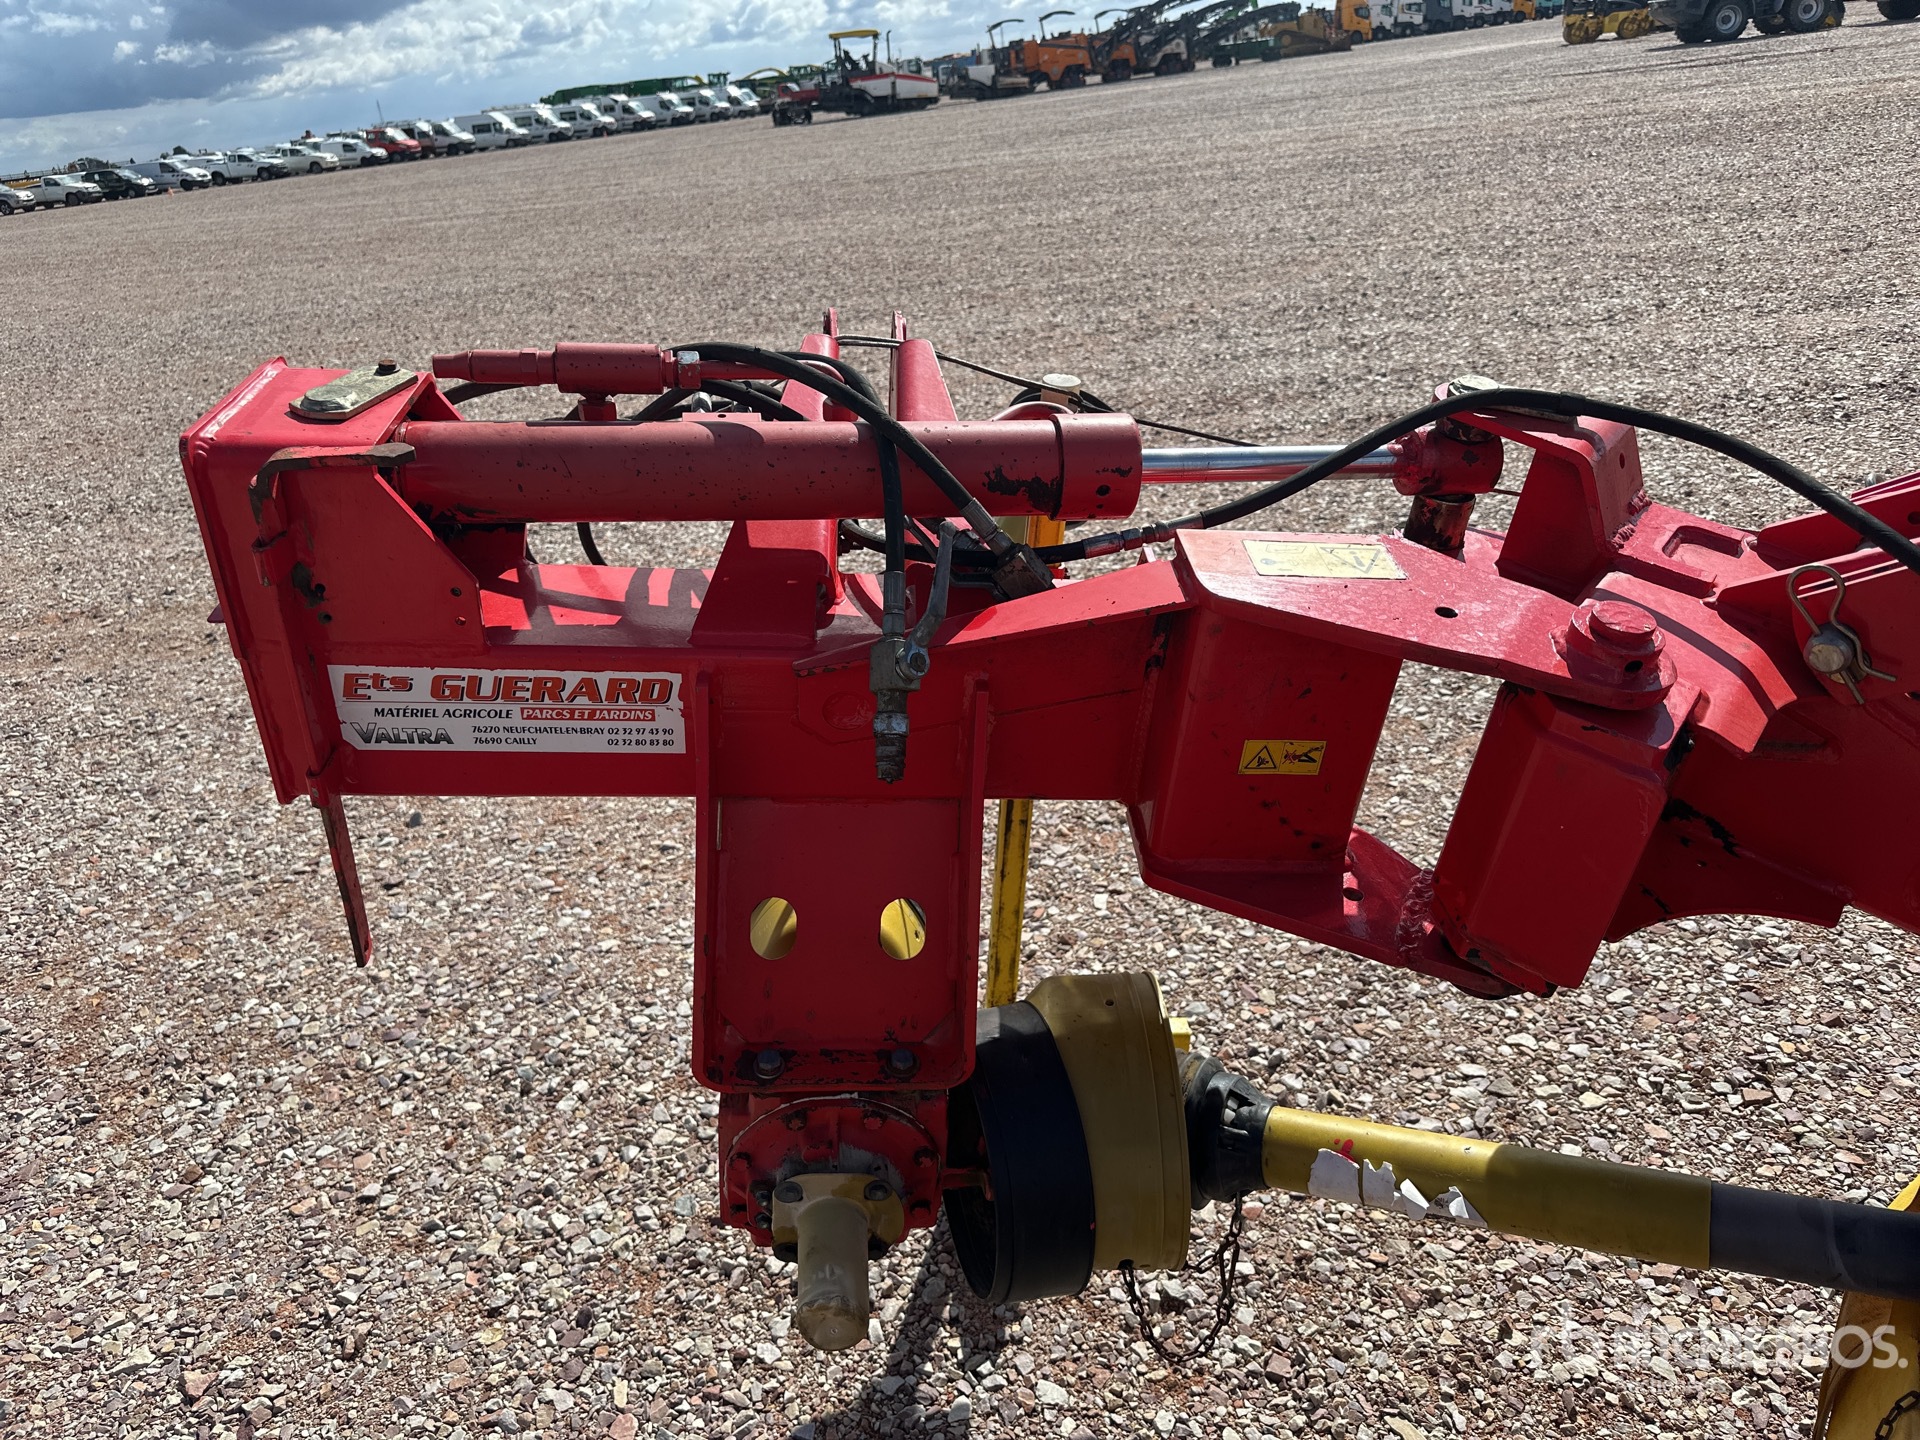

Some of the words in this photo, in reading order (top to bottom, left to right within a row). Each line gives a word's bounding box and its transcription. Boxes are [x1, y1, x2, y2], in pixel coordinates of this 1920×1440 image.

[342, 672, 414, 700] Ets
[430, 674, 674, 705] GUERARD
[373, 705, 440, 719] MATÉRIEL
[442, 708, 514, 720] AGRICOLE
[522, 709, 571, 719] PARCS
[573, 710, 593, 720] ET
[593, 710, 653, 721] JARDINS
[350, 722, 455, 745] VALTRA
[471, 725, 501, 734] 76270
[607, 727, 619, 736] 02
[622, 727, 633, 736] 32
[635, 728, 647, 736] 97
[648, 728, 660, 736] 43
[662, 728, 674, 736] 90
[473, 737, 502, 745] 76690
[504, 737, 538, 745] CAILLY
[607, 738, 619, 746] 02
[622, 738, 633, 746] 32
[635, 738, 647, 746] 80
[649, 738, 660, 747] 83
[662, 738, 675, 747] 80
